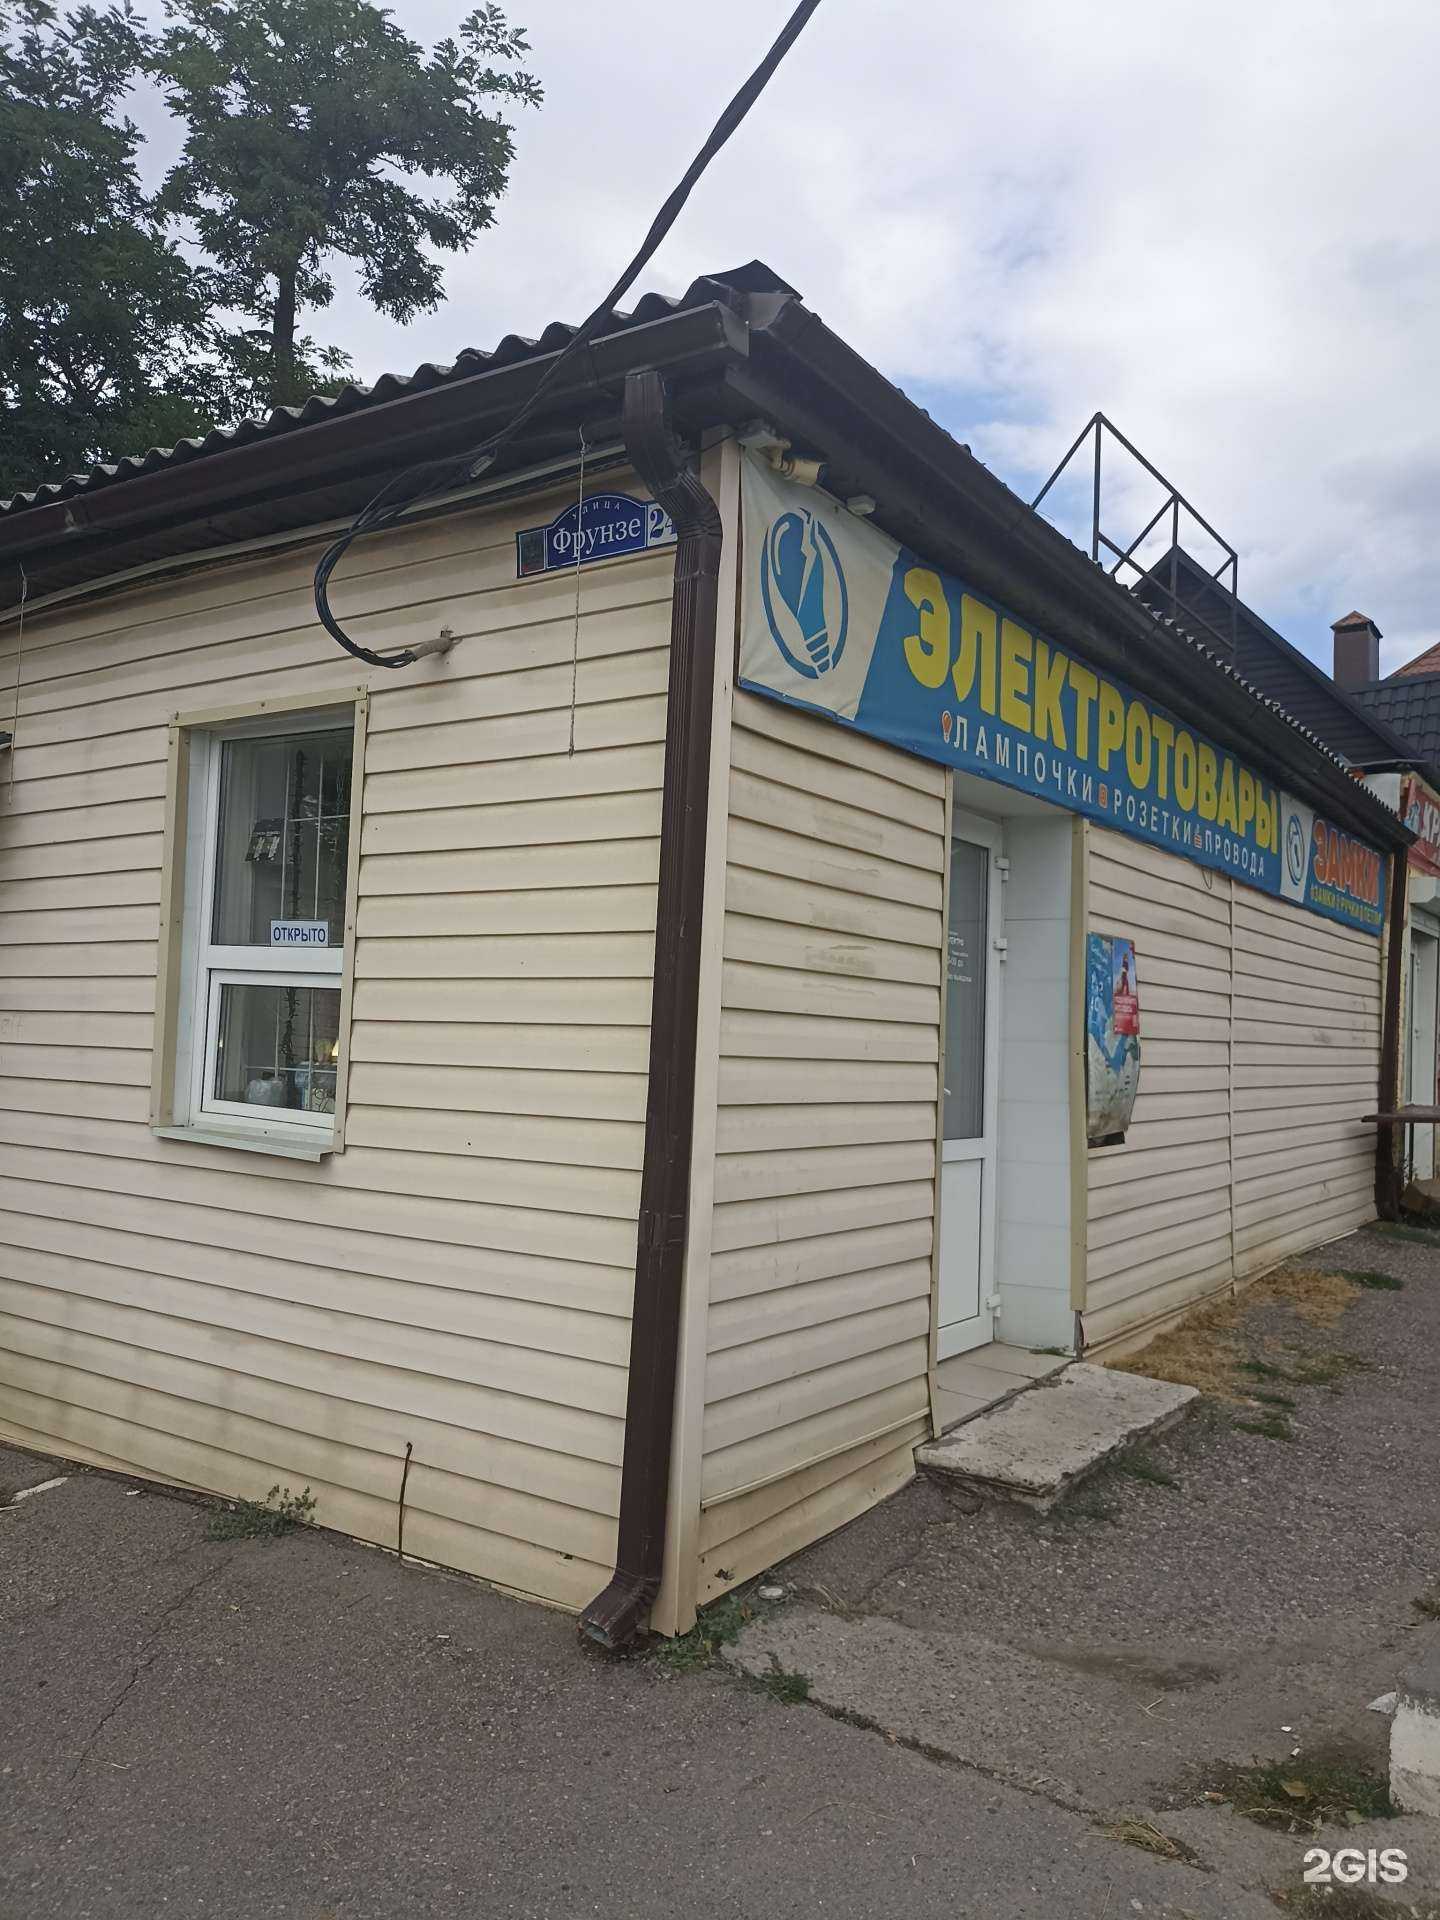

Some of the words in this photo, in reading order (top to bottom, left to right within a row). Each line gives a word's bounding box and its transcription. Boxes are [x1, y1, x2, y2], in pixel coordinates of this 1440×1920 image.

[552, 517, 642, 558] Фрунзе
[903, 567, 1278, 855] ЭЛЕКТРОТОВАРЫ
[953, 715, 1093, 804] ЛАМПОЧКИ
[1113, 788, 1192, 845] РОЗЕТКИ
[1205, 829, 1265, 878] ПРОВОДА
[1313, 819, 1381, 907] ЗАМКИ
[273, 926, 326, 943] ОТКРЫТО
